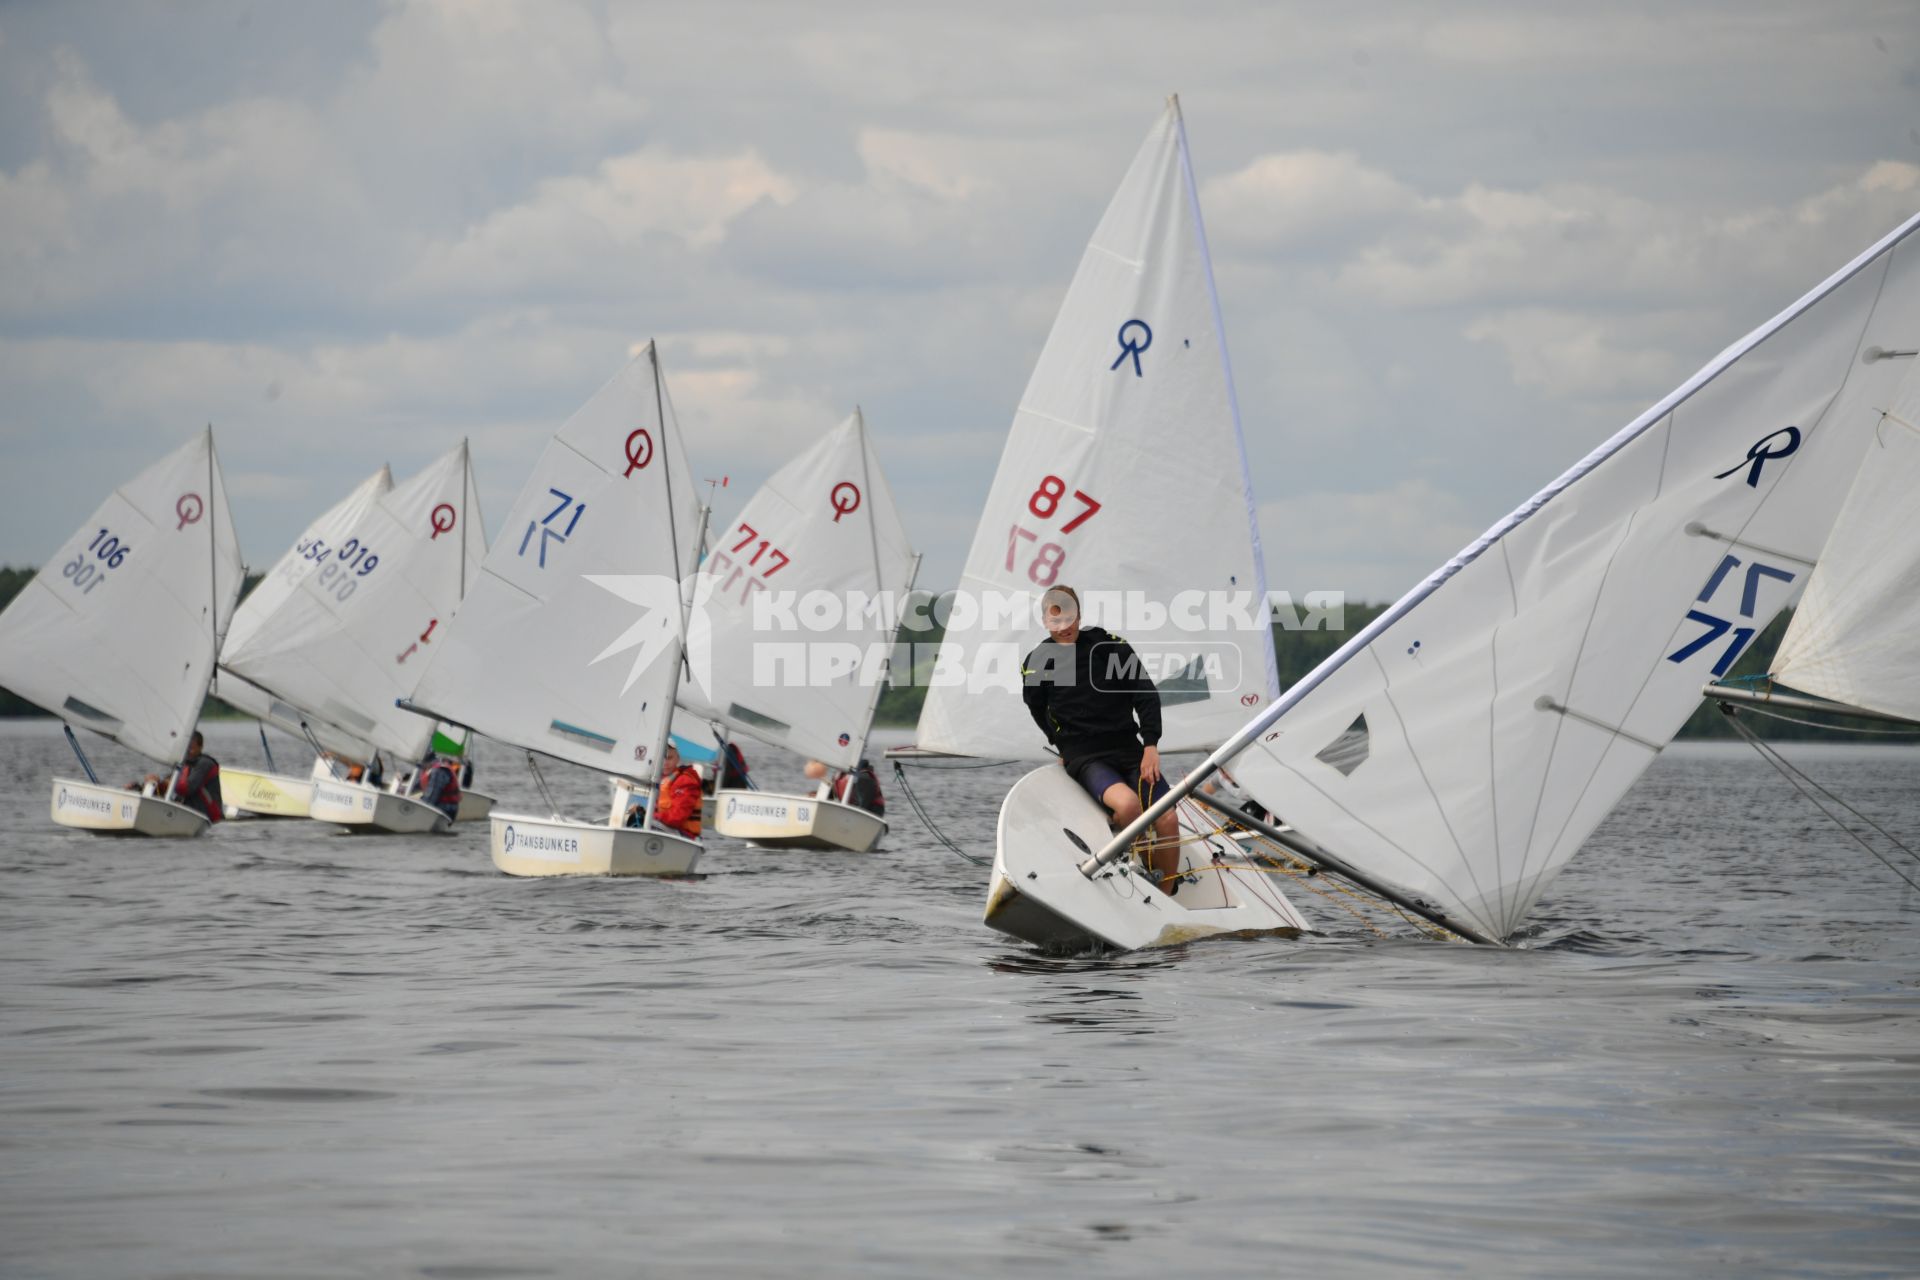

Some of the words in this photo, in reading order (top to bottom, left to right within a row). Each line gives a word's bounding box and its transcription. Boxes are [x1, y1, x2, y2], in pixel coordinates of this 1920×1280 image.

[541, 488, 586, 537] 71
[1028, 475, 1102, 535] 87
[88, 528, 130, 570] 106
[338, 538, 378, 577] 019
[731, 523, 790, 578] 717
[1666, 609, 1756, 678] 71
[516, 833, 578, 853] TRANSBUNKER
